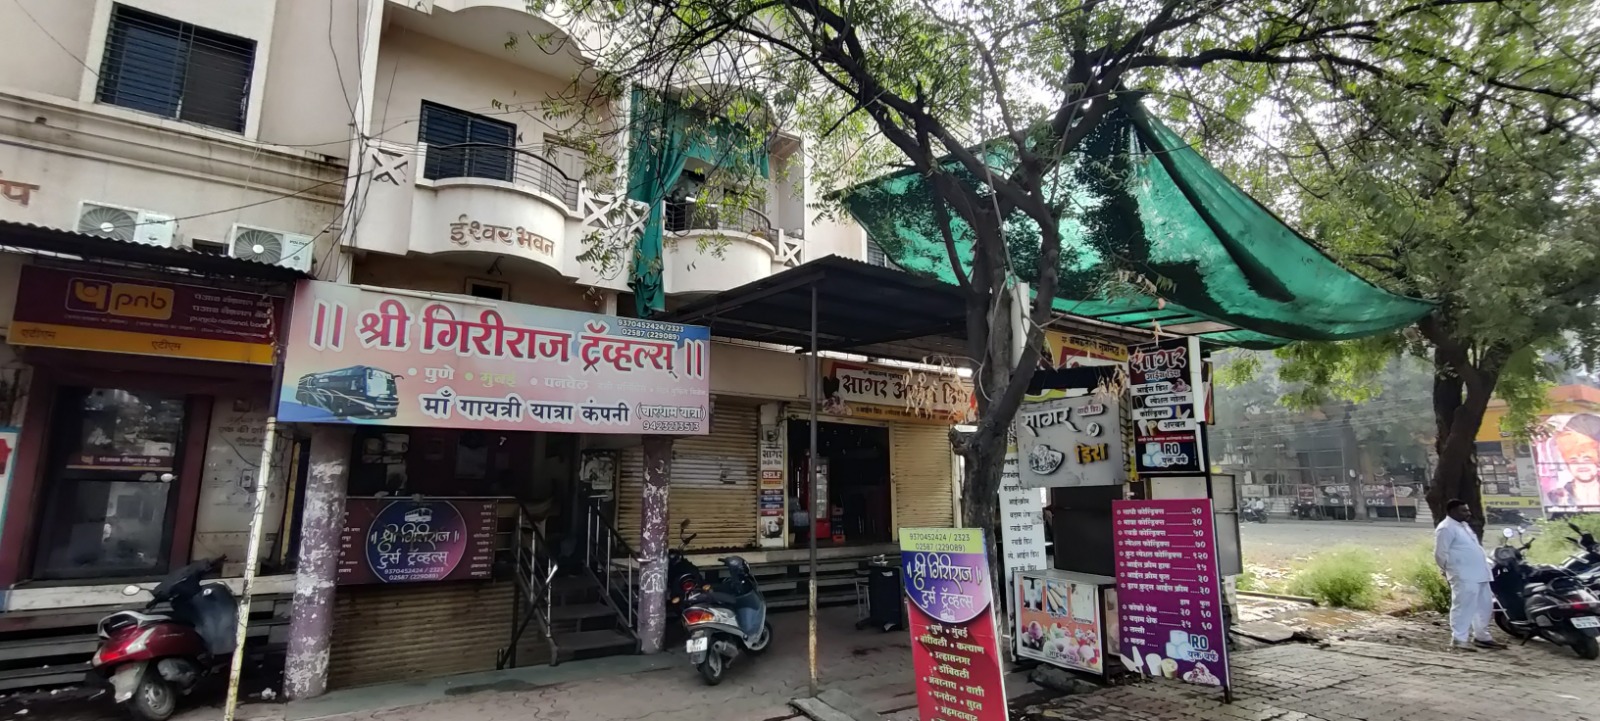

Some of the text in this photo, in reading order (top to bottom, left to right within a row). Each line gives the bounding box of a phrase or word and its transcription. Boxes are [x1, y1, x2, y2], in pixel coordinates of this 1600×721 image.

[450, 213, 554, 258] ईश्वर भवन
[115, 290, 167, 310] pnb
[358, 299, 411, 348] श्री
[423, 304, 572, 363] गिरीराज
[618, 319, 685, 333] 9370452424/2323
[622, 329, 681, 341] 02587 (229089)
[151, 340, 182, 351] एटीएम
[1131, 346, 1187, 374] सागर
[424, 364, 455, 384] पुणे
[543, 374, 589, 391] पनवेल
[841, 374, 888, 399] सागर
[423, 389, 453, 415] माँ
[459, 393, 522, 419] गायत्री
[530, 402, 574, 420] यात्रा
[581, 399, 630, 422] कंपनी
[643, 421, 700, 431] 9423213513
[1021, 407, 1081, 437] सागर
[1163, 420, 1185, 429] शरबत
[1165, 443, 1180, 455] RO
[763, 471, 782, 479] SELF
[1191, 507, 1202, 515] २०
[1191, 518, 1202, 527] ३०
[909, 533, 947, 541] 9370452424
[954, 534, 970, 542] 2323
[1193, 529, 1204, 538] ५०
[1195, 540, 1206, 548] ७०
[1193, 551, 1208, 560] १२०
[914, 552, 926, 590] श्री
[1196, 563, 1207, 571] १५
[1199, 586, 1210, 595] ३०
[931, 623, 968, 639] पुणे मुंबई
[957, 642, 984, 654] कल्याण
[1191, 635, 1207, 649] RO
[934, 690, 957, 704] पनवेल
